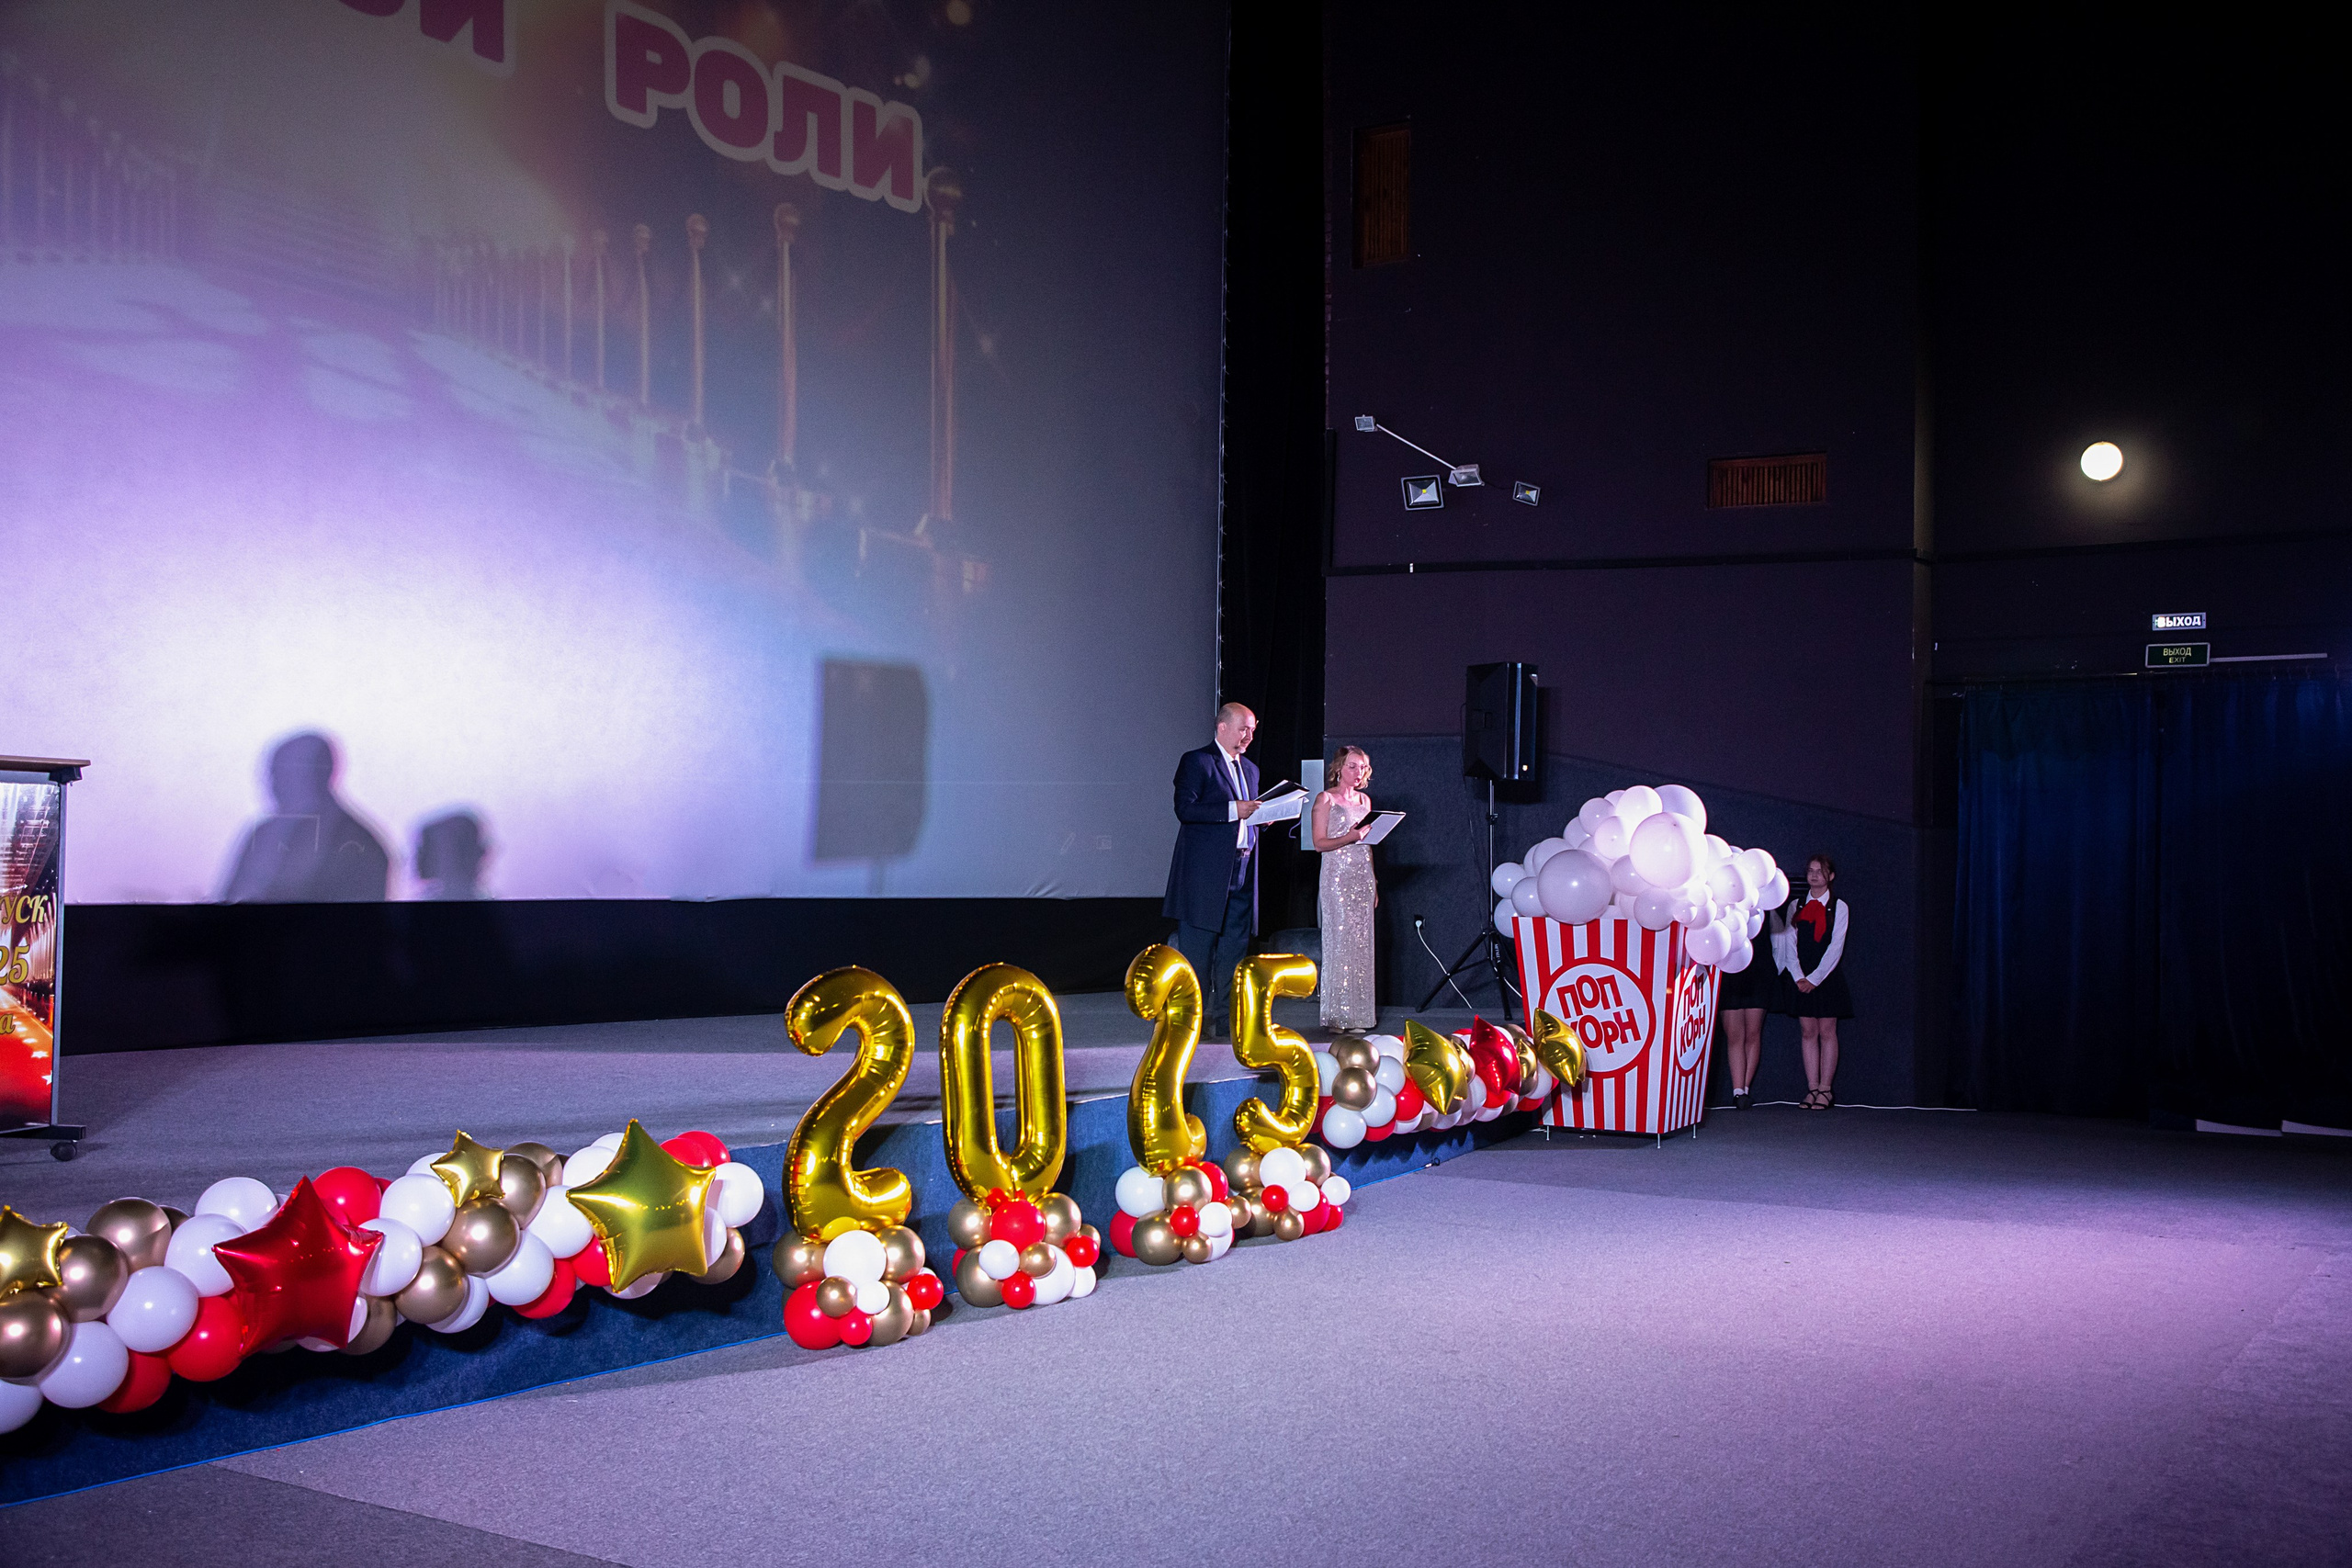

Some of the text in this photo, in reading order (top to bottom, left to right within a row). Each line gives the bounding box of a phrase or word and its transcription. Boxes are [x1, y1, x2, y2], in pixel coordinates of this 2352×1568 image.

[606, 3, 922, 212] РОЛИ
[2163, 648, 2192, 657] ВЫХОД
[1556, 974, 1623, 1019] ПОП
[1682, 972, 1704, 1021] ПОП
[1679, 1004, 1706, 1058] КОРН
[781, 943, 1320, 1244] 2025
